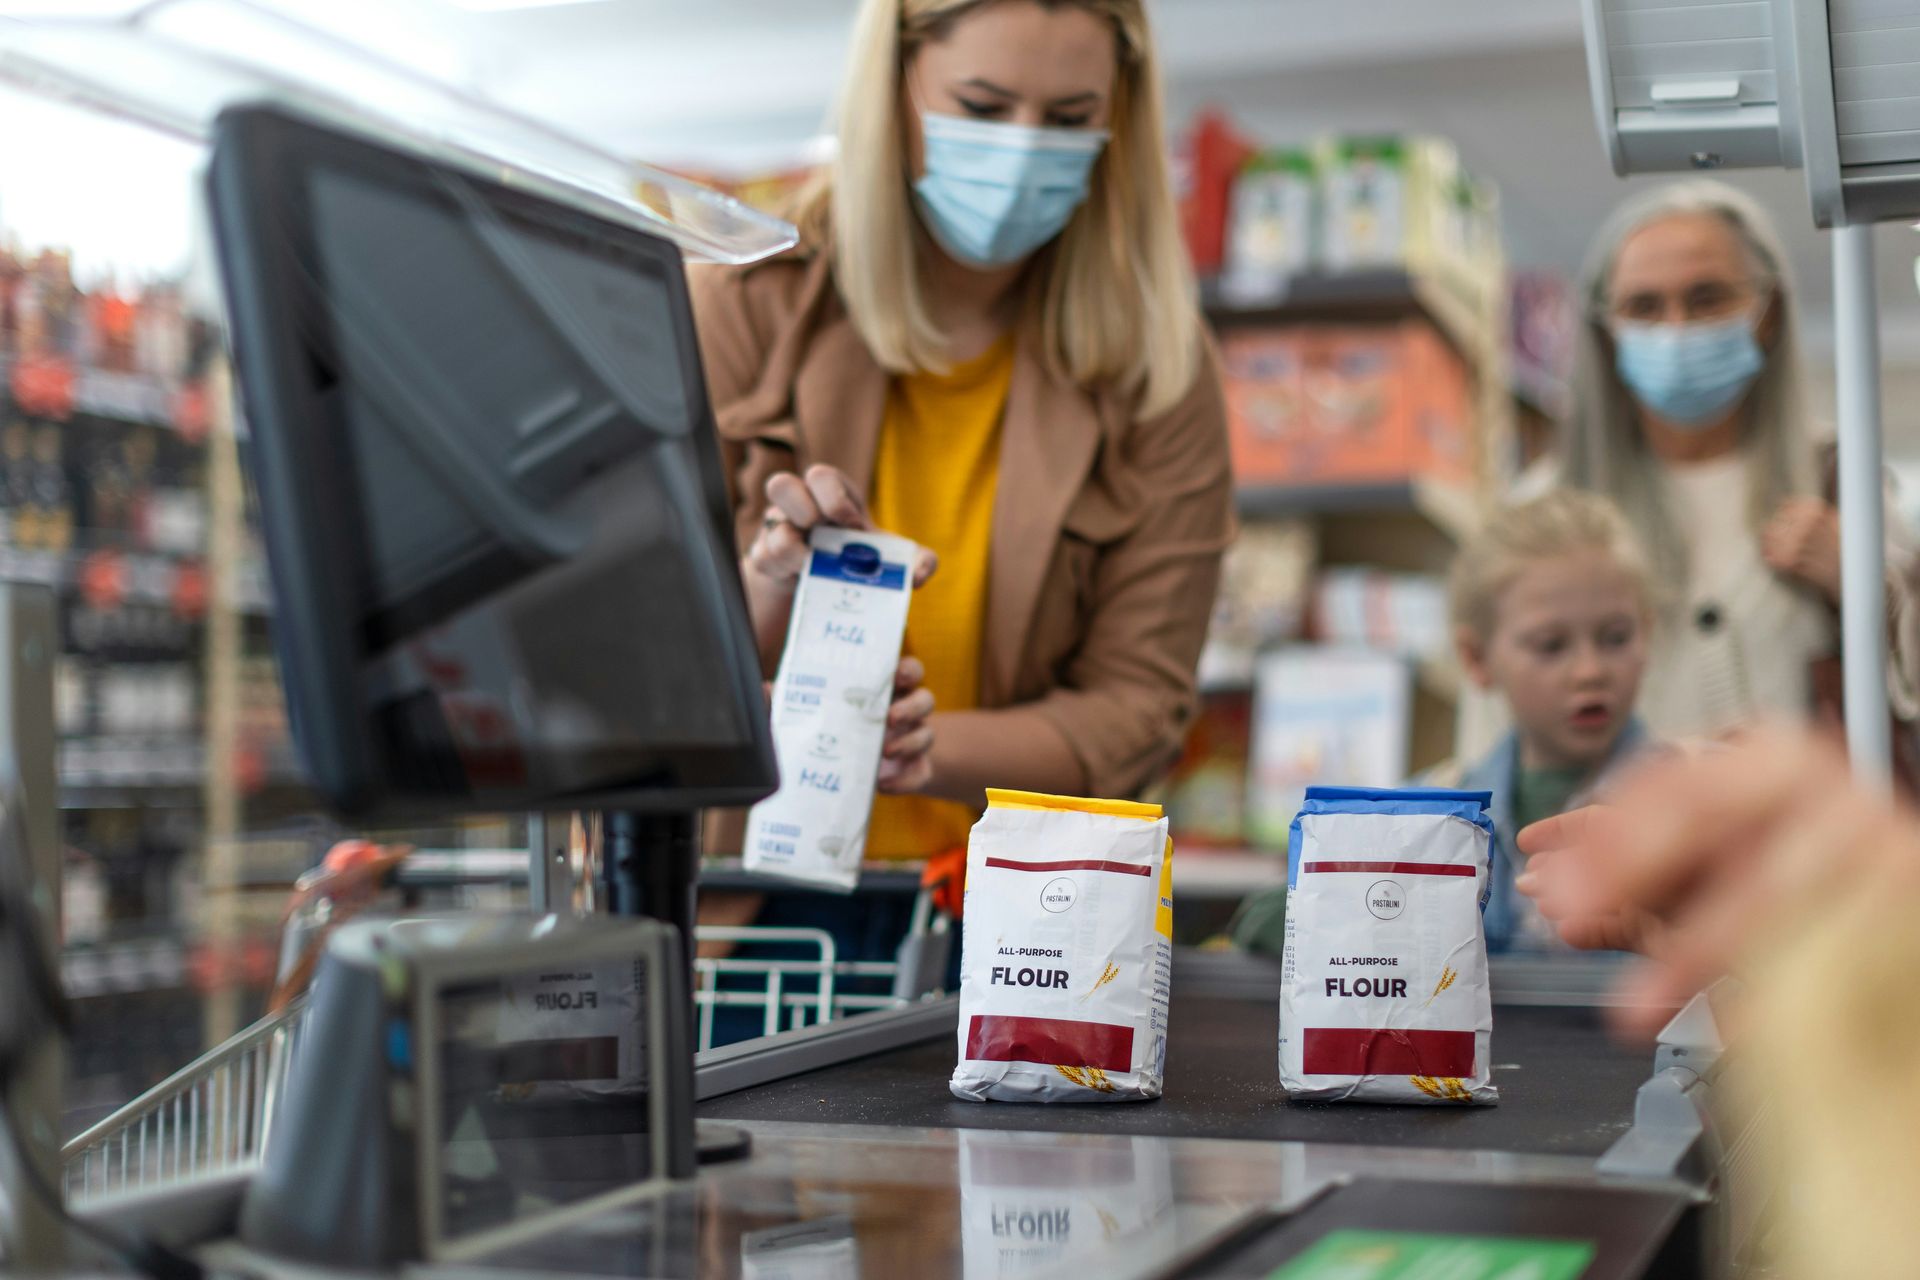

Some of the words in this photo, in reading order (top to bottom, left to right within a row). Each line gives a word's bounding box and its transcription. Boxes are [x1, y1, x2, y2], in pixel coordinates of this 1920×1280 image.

[823, 619, 865, 645] Milk
[799, 767, 841, 793] Milk
[1045, 895, 1072, 903] PASTALINI
[1372, 899, 1400, 908] PASTALINI
[998, 947, 1063, 958] ALL-PURPOSE
[1329, 957, 1398, 966] ALL-PURPOSE
[991, 966, 1069, 989] FLOUR
[1325, 977, 1407, 998] FLOUR
